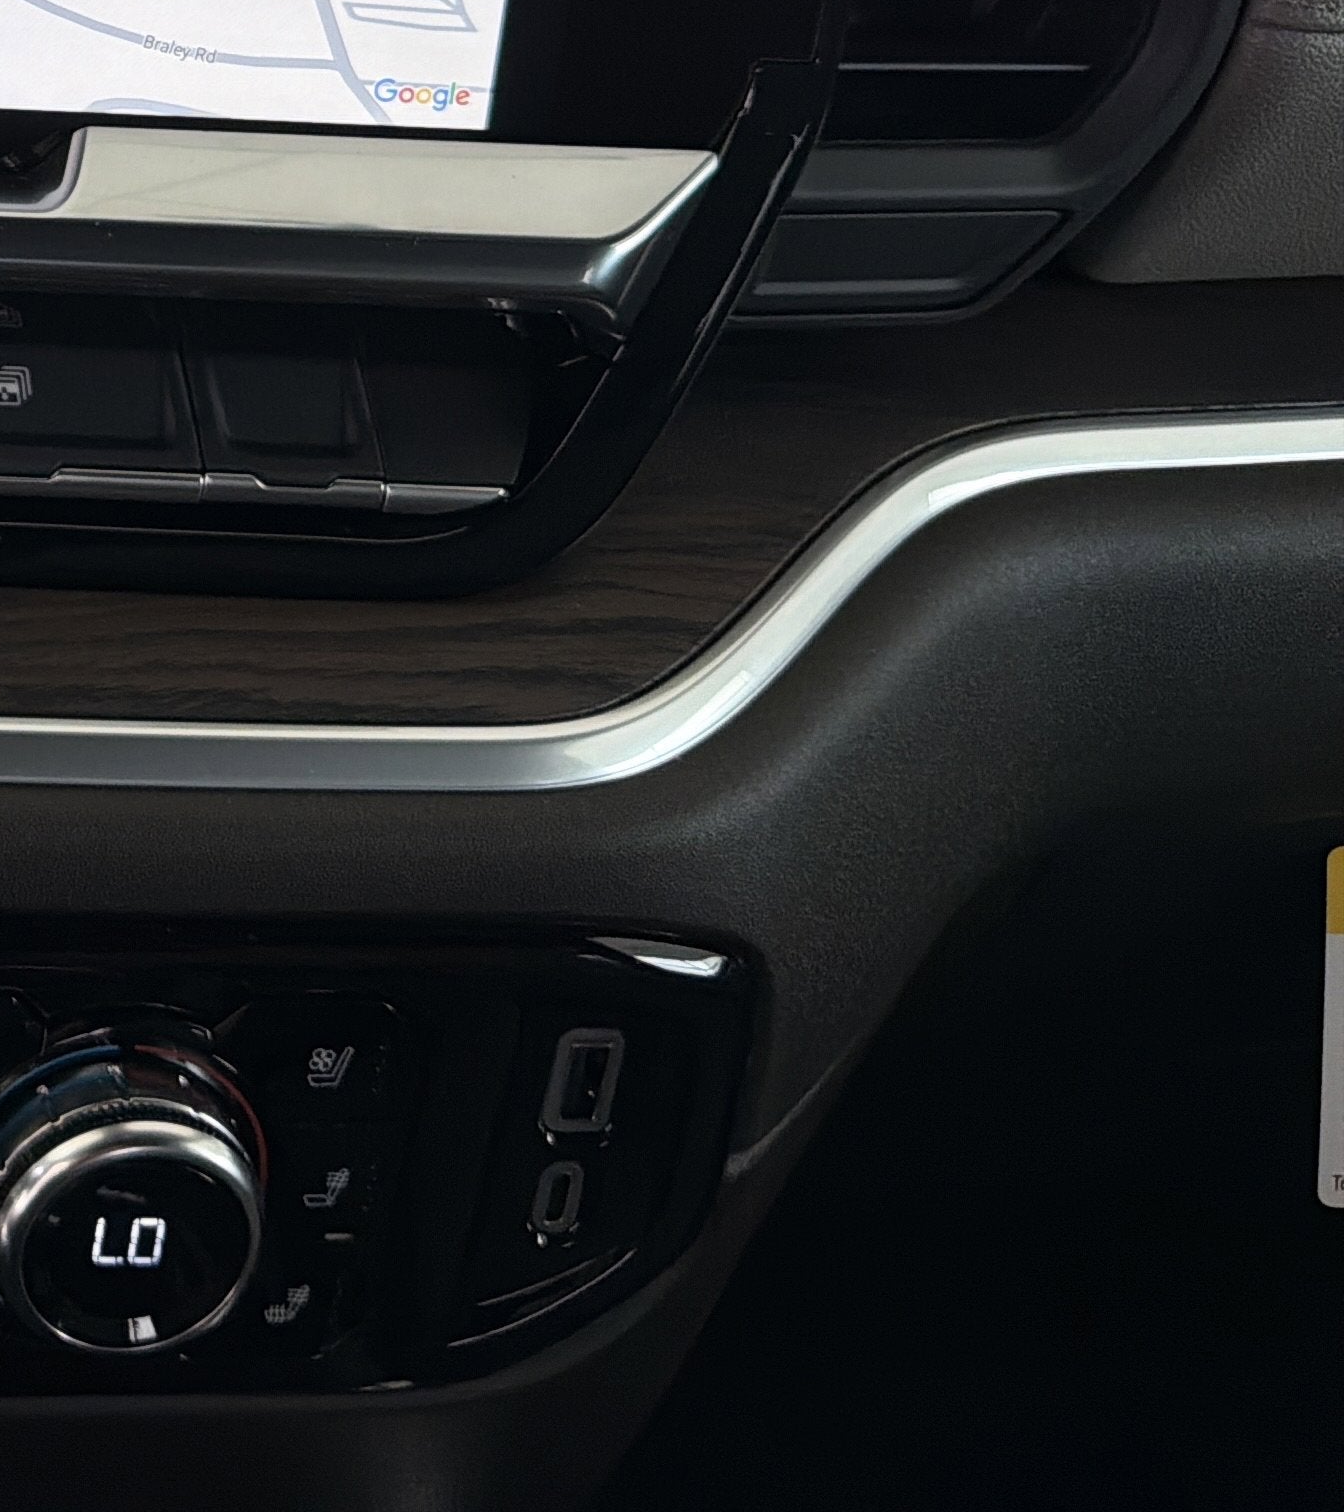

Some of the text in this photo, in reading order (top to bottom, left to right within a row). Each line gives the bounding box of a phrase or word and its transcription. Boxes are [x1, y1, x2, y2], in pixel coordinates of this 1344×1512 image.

[143, 36, 218, 64] Braley Rd
[374, 78, 471, 112] Google
